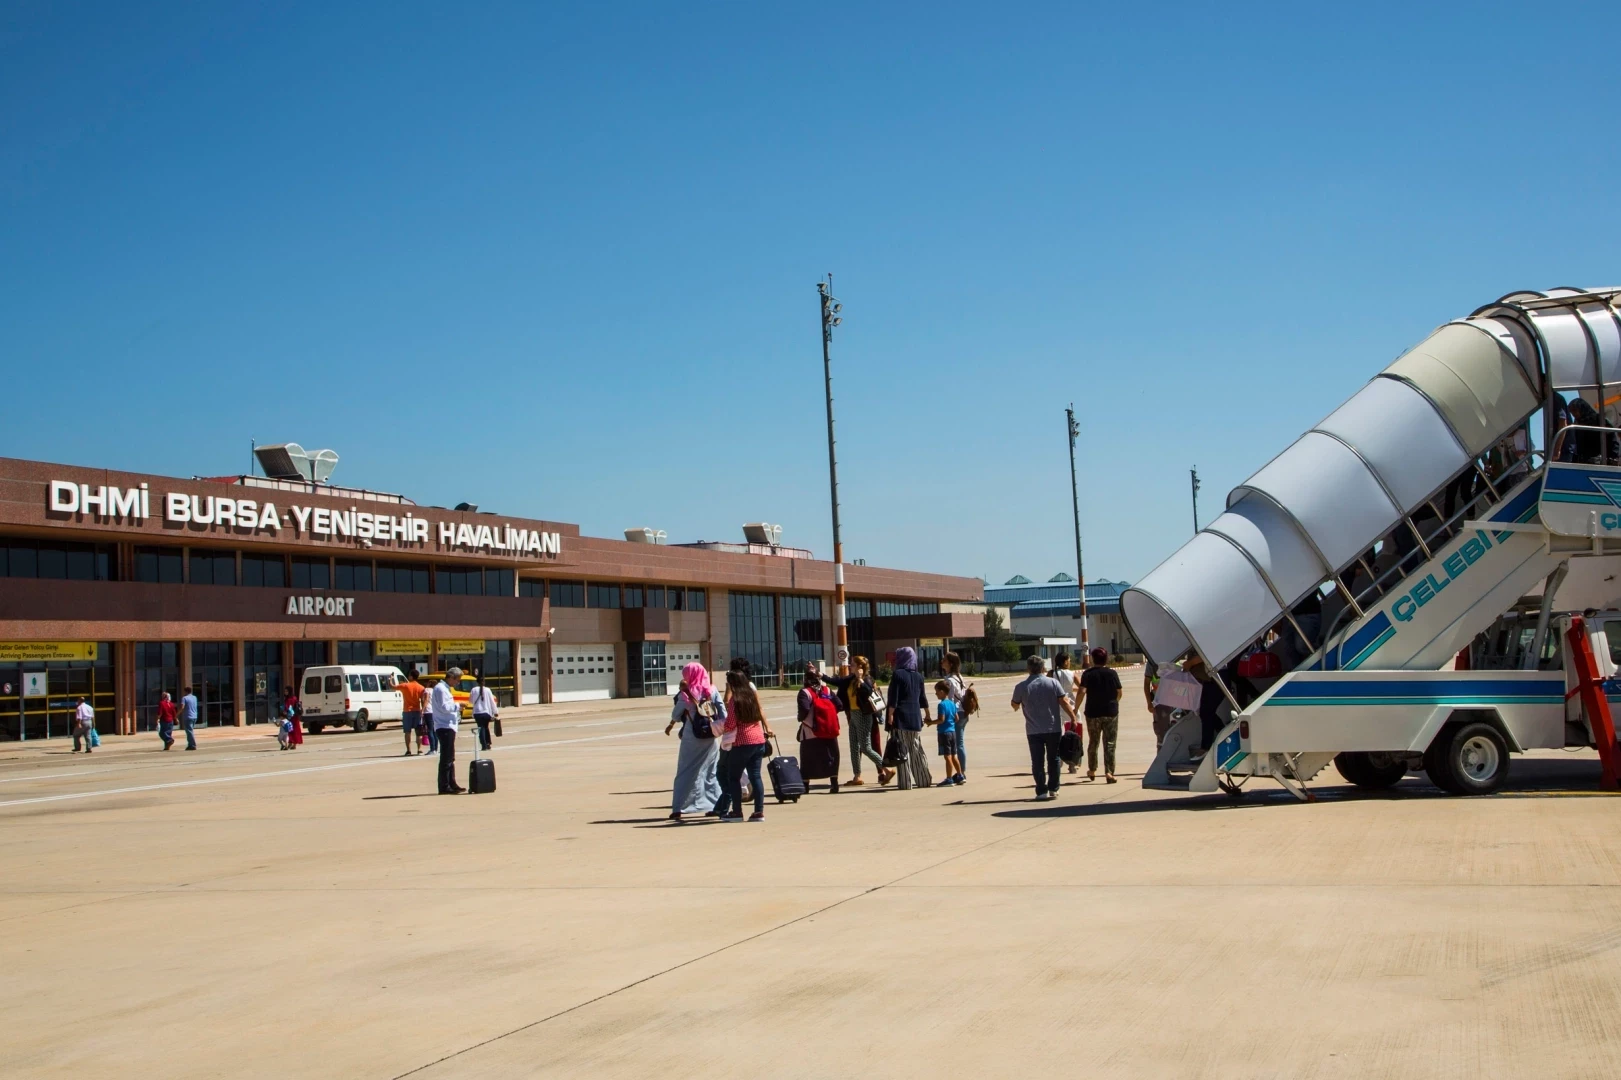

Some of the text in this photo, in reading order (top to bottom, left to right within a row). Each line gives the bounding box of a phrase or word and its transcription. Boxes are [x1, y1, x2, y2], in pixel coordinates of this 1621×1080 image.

[50, 479, 150, 519] DHMİ
[438, 521, 561, 554] HAVALİMANI
[286, 595, 355, 617] AIRPORT
